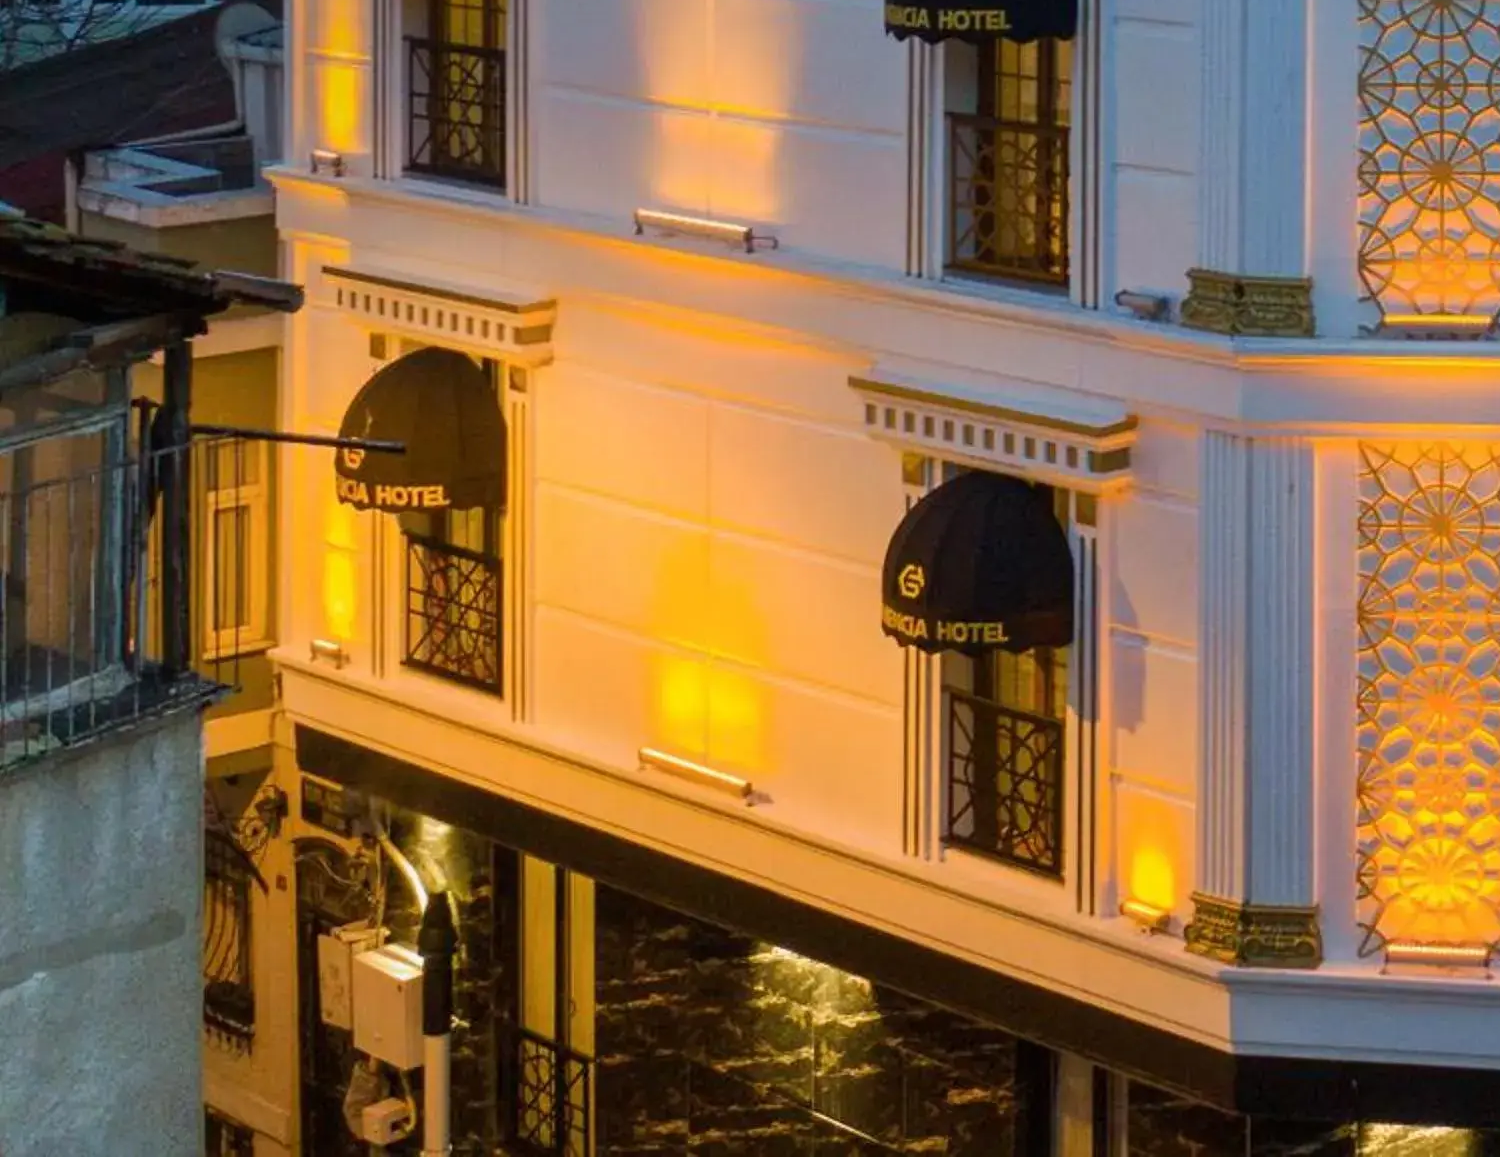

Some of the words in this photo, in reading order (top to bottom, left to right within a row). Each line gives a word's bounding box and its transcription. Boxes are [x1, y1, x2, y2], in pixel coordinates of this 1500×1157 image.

[938, 8, 1013, 31] HOTEL
[375, 484, 450, 508] HOTEL
[935, 620, 1010, 645] HOTEL
